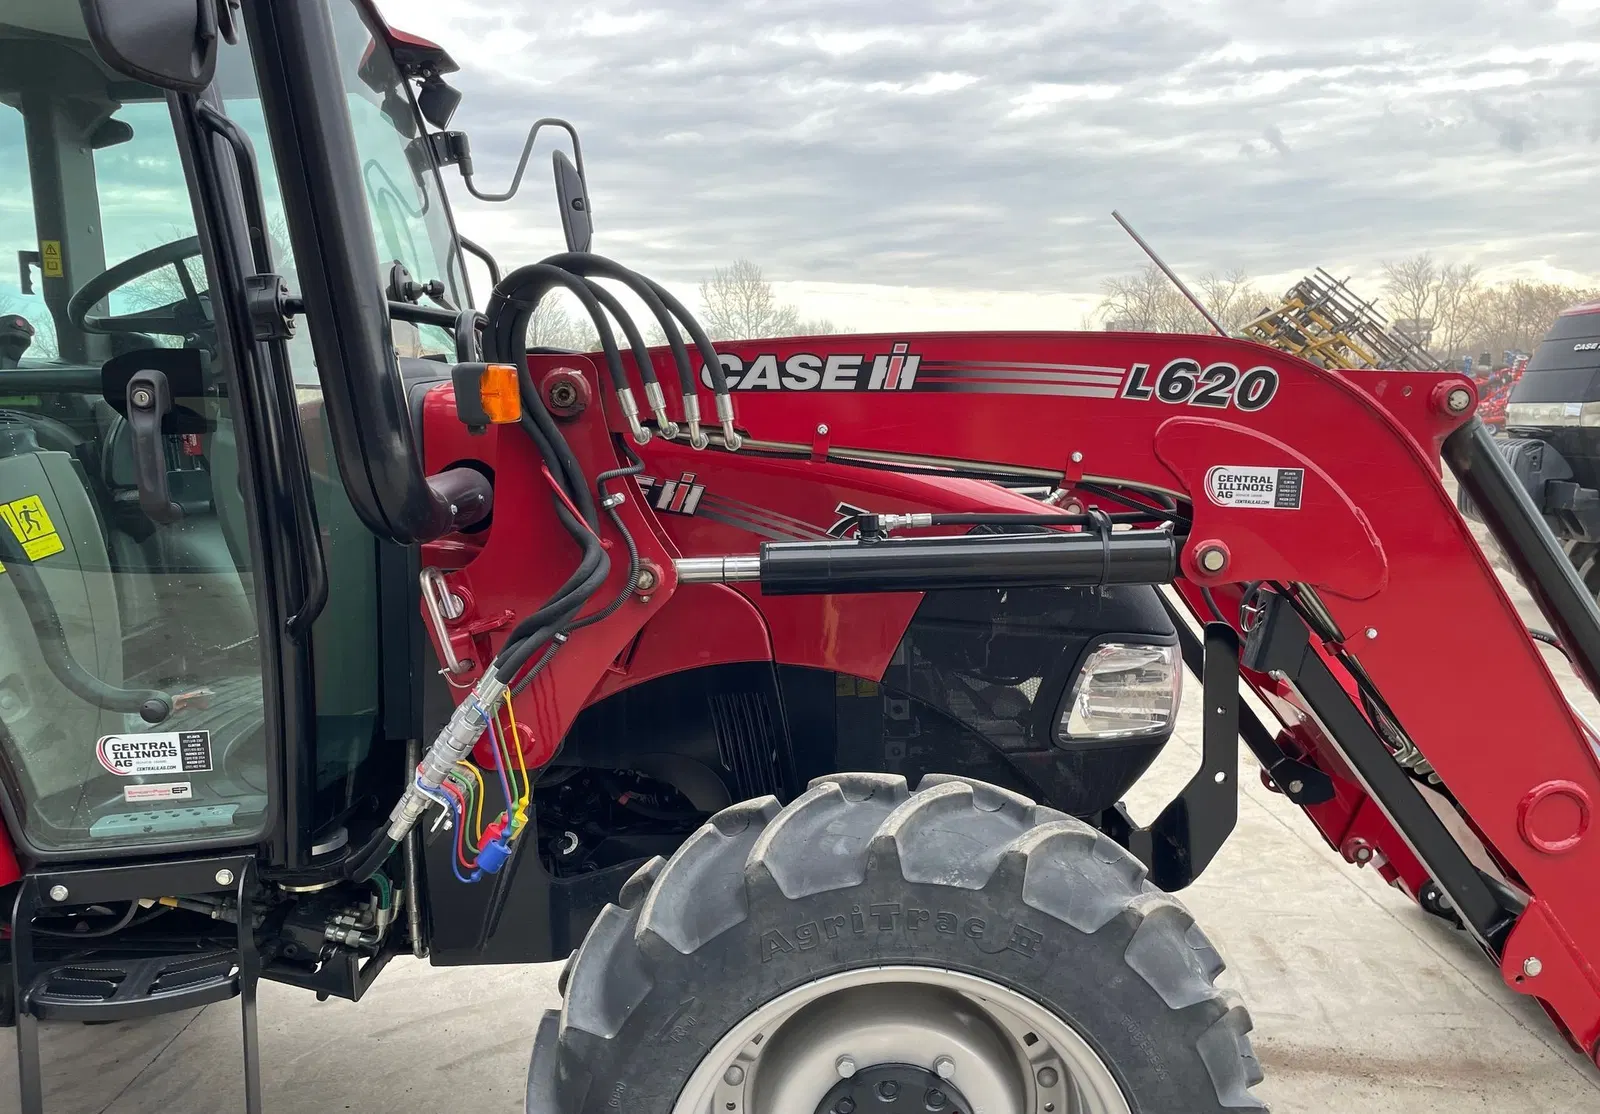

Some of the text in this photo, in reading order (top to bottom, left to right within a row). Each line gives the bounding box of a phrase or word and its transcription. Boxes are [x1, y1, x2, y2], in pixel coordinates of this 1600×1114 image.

[701, 353, 864, 391] CASE
[1120, 357, 1280, 412] L620
[1217, 474, 1274, 484] CENTRAL
[1217, 483, 1274, 492] ILLINOIS
[111, 742, 176, 752] CENTRAL
[112, 749, 178, 760] ILLINOIS
[114, 759, 133, 768] AG
[760, 903, 987, 962] AgriTrac
